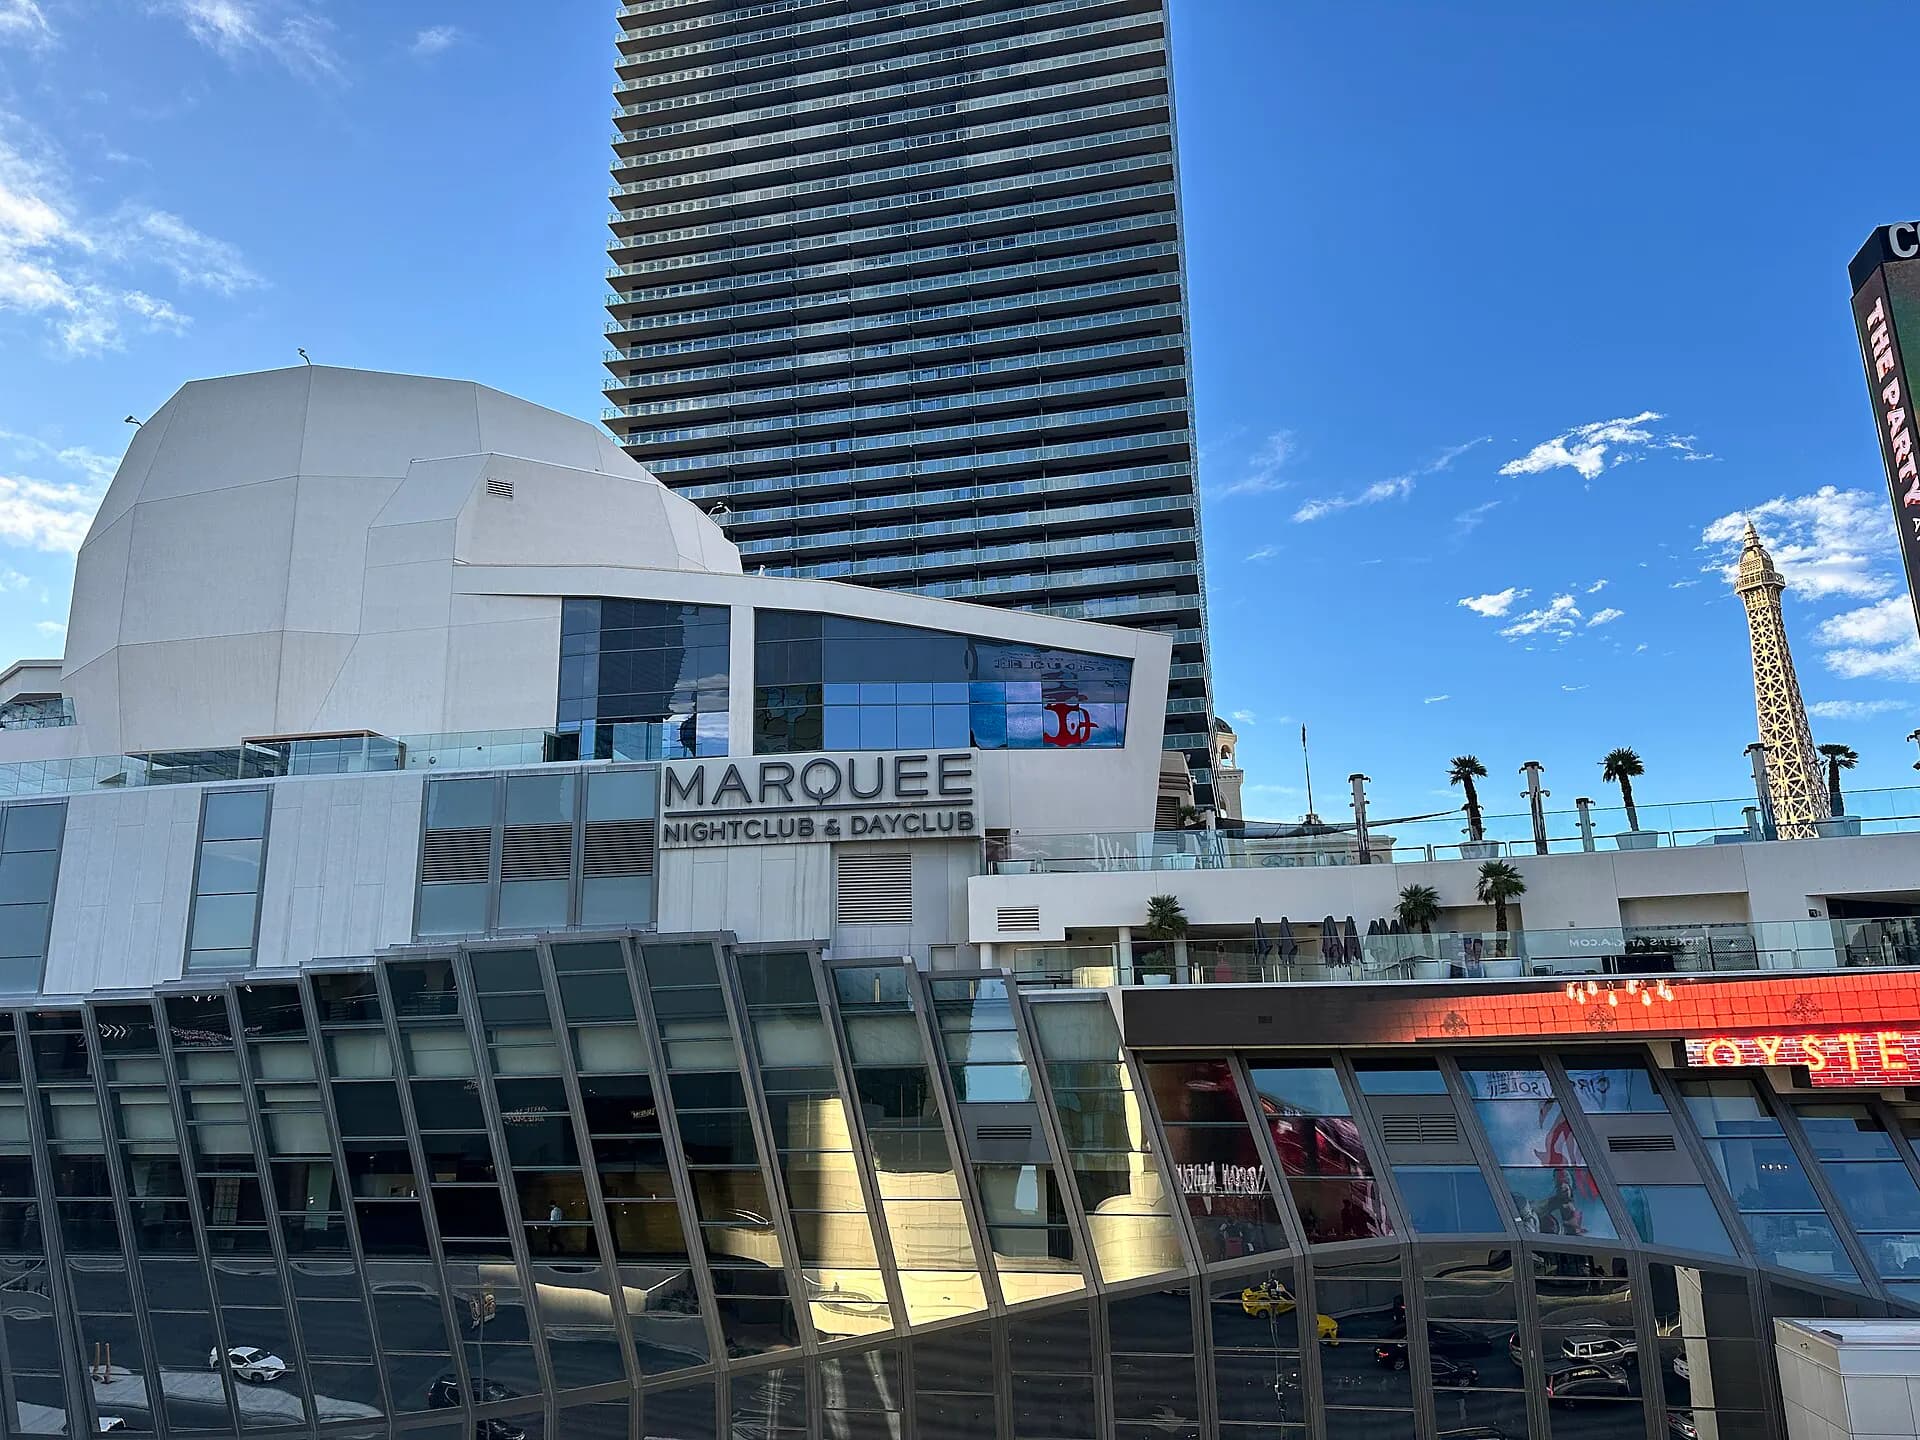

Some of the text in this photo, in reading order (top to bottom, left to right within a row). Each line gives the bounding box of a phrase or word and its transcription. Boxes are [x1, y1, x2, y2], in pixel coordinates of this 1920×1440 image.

[1866, 296, 1895, 383] THE
[665, 752, 973, 806] MARQUEE
[663, 811, 975, 842] NIGHTCLUB & DAYCLUB
[1706, 1032, 1908, 1071] OYSTE
